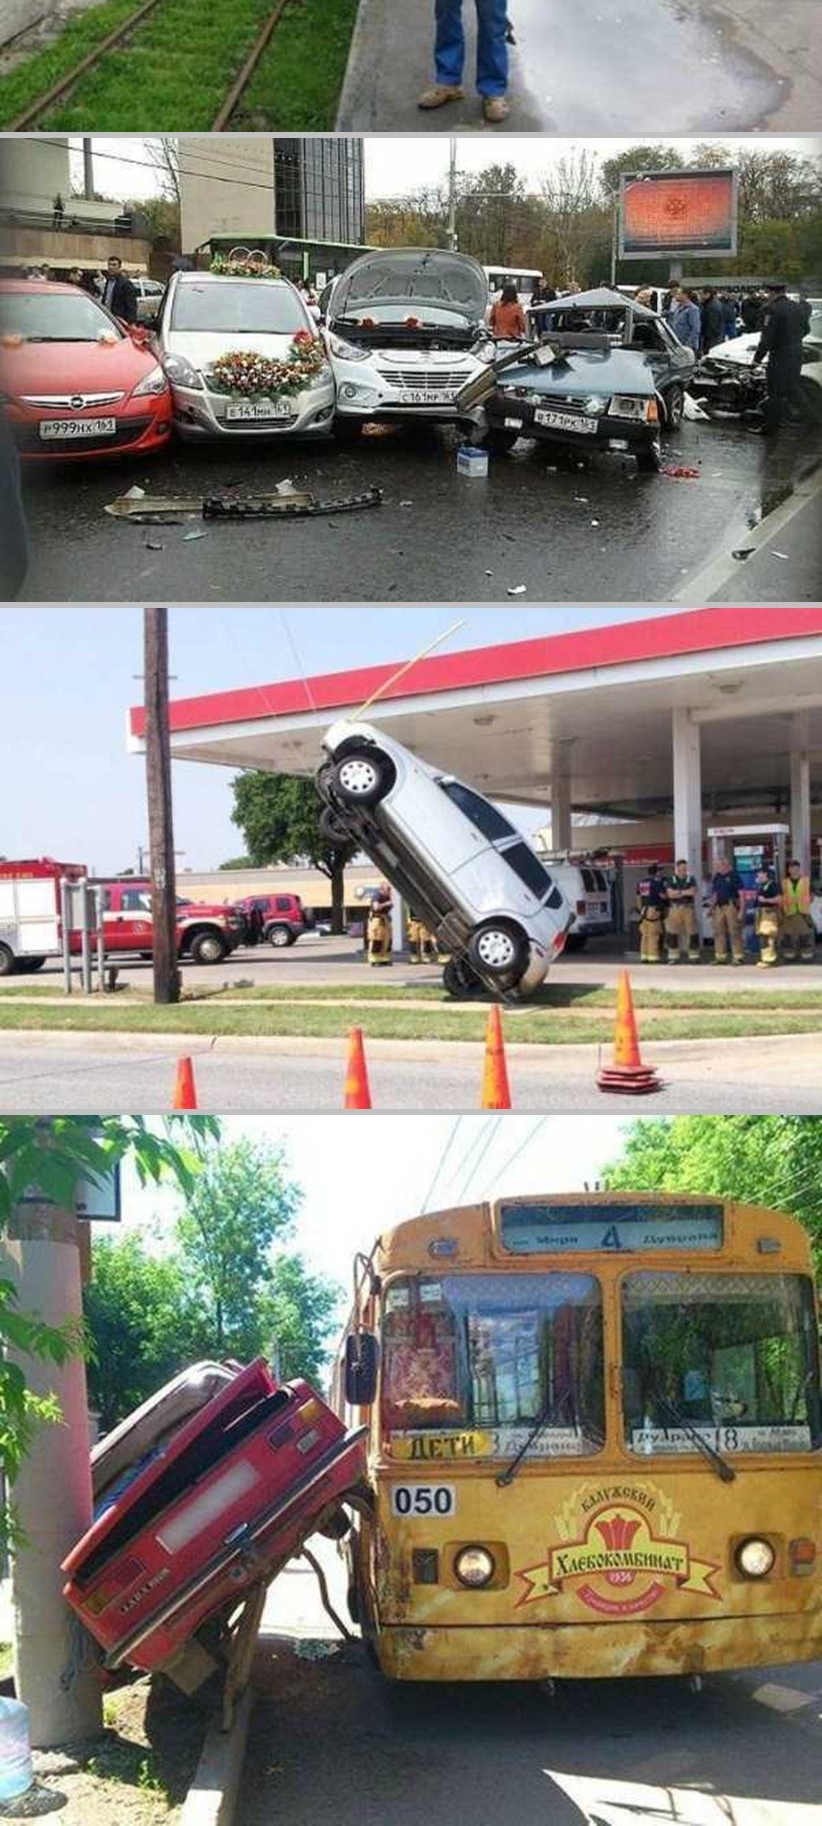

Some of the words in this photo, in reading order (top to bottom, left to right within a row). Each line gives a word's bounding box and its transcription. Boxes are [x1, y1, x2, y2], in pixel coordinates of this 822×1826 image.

[601, 1224, 623, 1249] 4
[410, 1435, 475, 1460] ДЕТИ
[395, 1487, 452, 1513] 050
